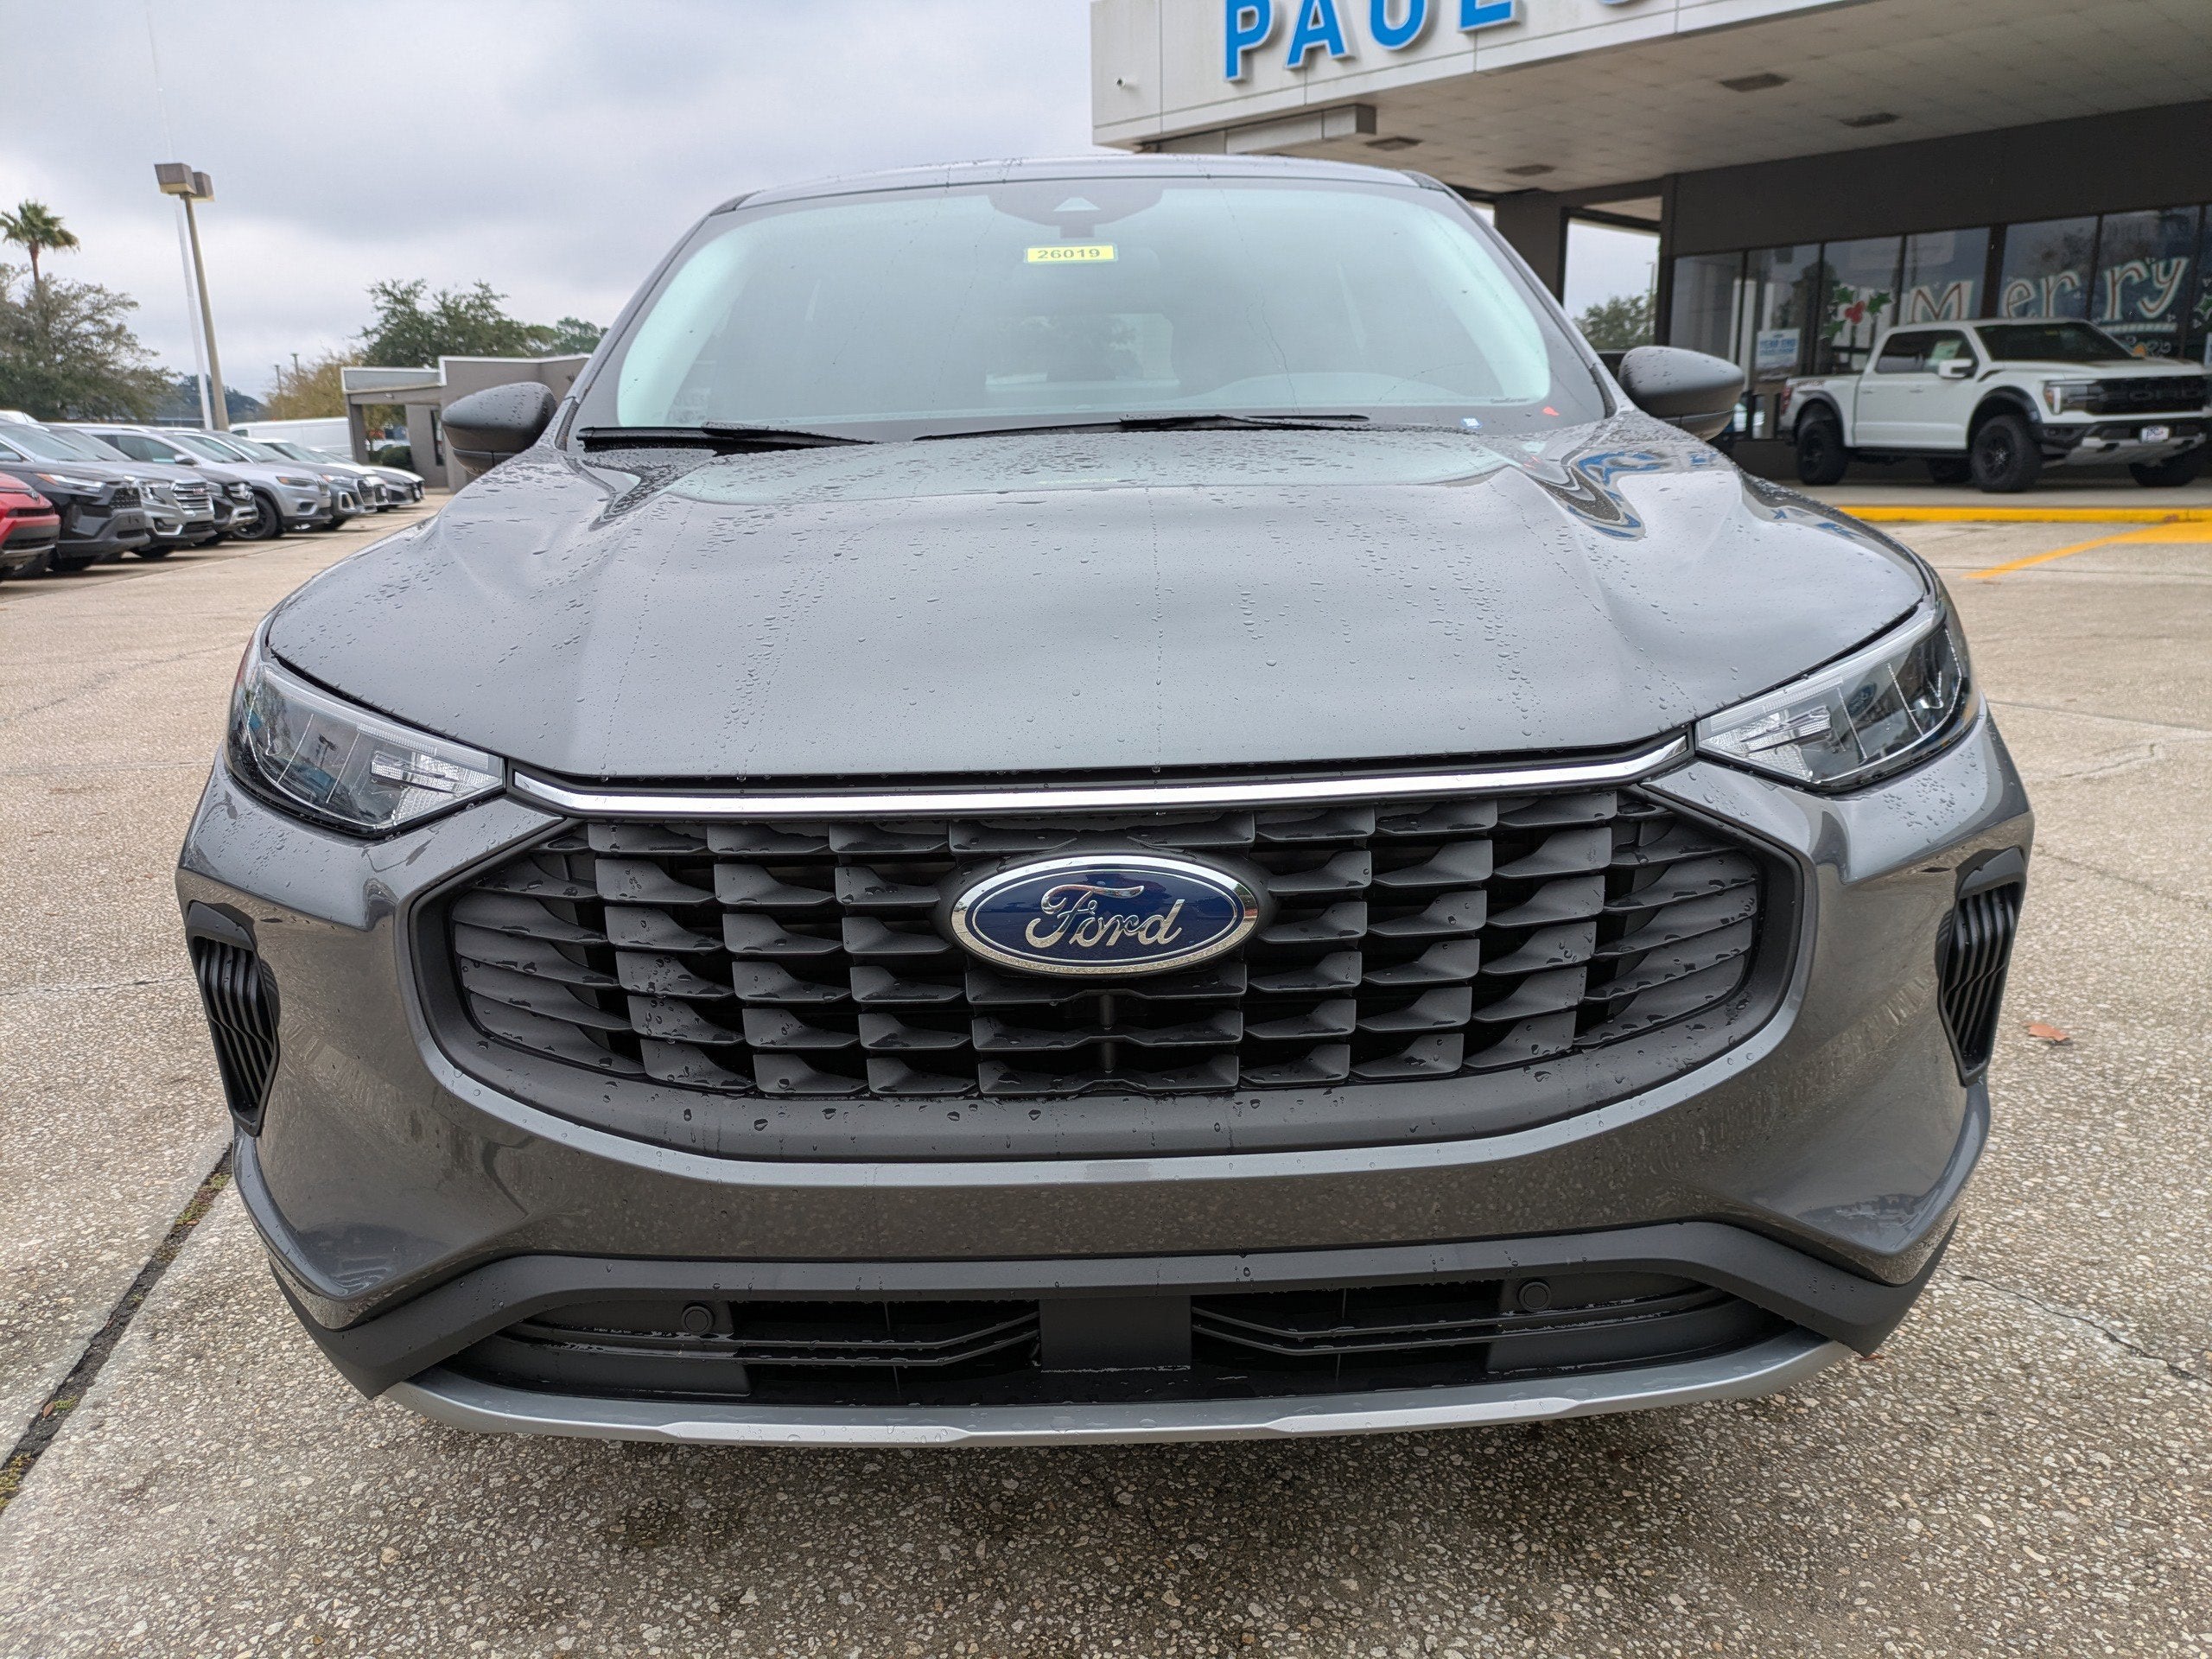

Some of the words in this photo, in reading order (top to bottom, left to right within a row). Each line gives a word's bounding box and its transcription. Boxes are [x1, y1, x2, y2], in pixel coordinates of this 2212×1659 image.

[1037, 249, 1101, 259] 26019
[1910, 257, 2190, 321] Merry
[1025, 884, 1185, 948] Ford
